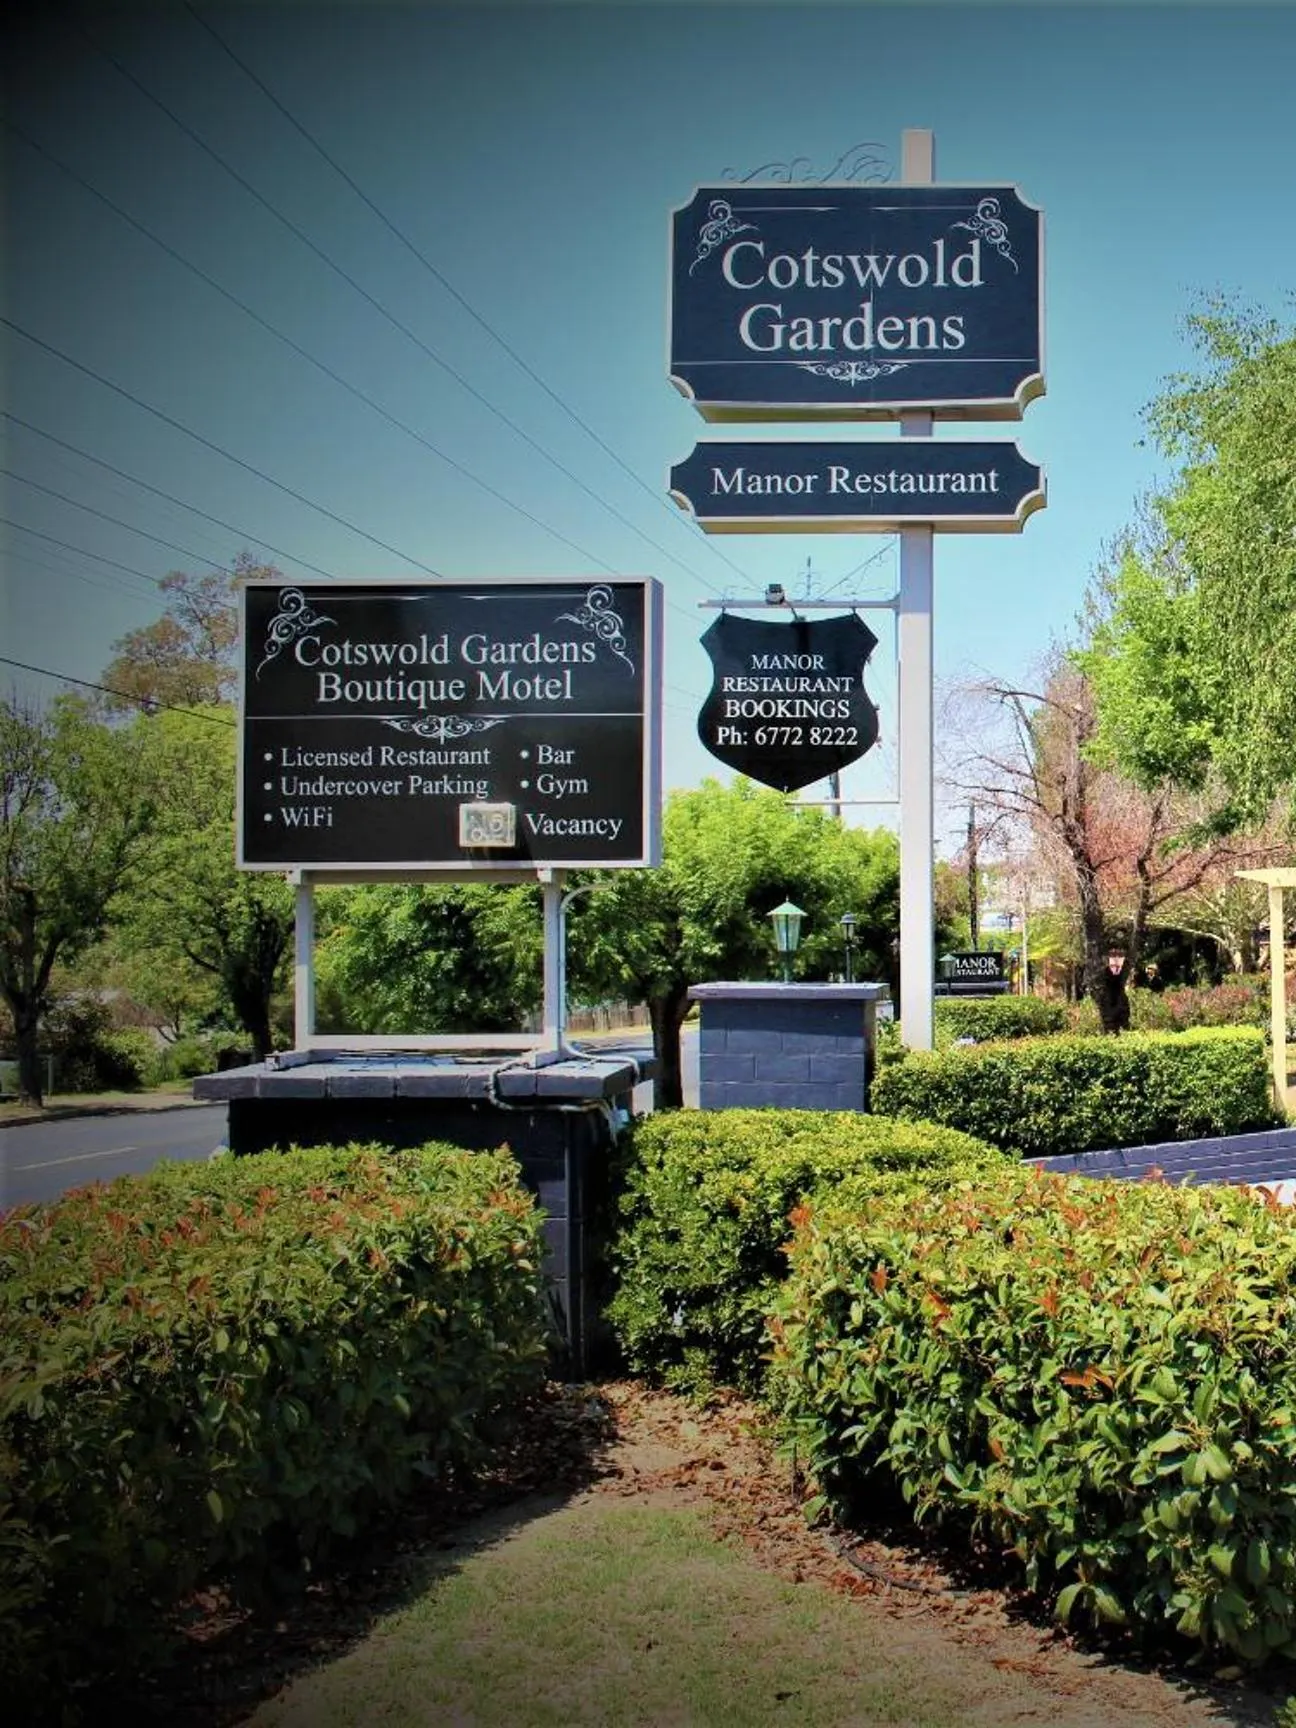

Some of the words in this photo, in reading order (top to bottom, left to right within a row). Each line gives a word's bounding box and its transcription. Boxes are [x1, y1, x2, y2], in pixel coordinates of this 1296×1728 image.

[721, 239, 985, 290] Cotswold
[738, 302, 966, 352] Gardens
[710, 467, 818, 494] Manor
[827, 465, 1000, 494] Restaurant
[294, 634, 450, 667] Cotswold
[460, 632, 597, 665] Gardens
[752, 655, 825, 670] MANOR
[317, 670, 466, 709] Boutique
[476, 670, 574, 700] Motel
[722, 677, 854, 692] RESTAURANT
[724, 699, 851, 719] BOOKINGS
[716, 726, 748, 746] Ph:
[754, 726, 803, 746] 6772
[809, 726, 858, 746] 8222
[280, 746, 373, 767] Licensed
[379, 745, 492, 767] Restaurant
[537, 744, 576, 765] Bar
[280, 775, 402, 796] Undercover
[408, 774, 489, 799] Parking
[537, 773, 588, 800] Gym
[280, 806, 333, 827] WiFi
[524, 812, 623, 841] Vacancy
